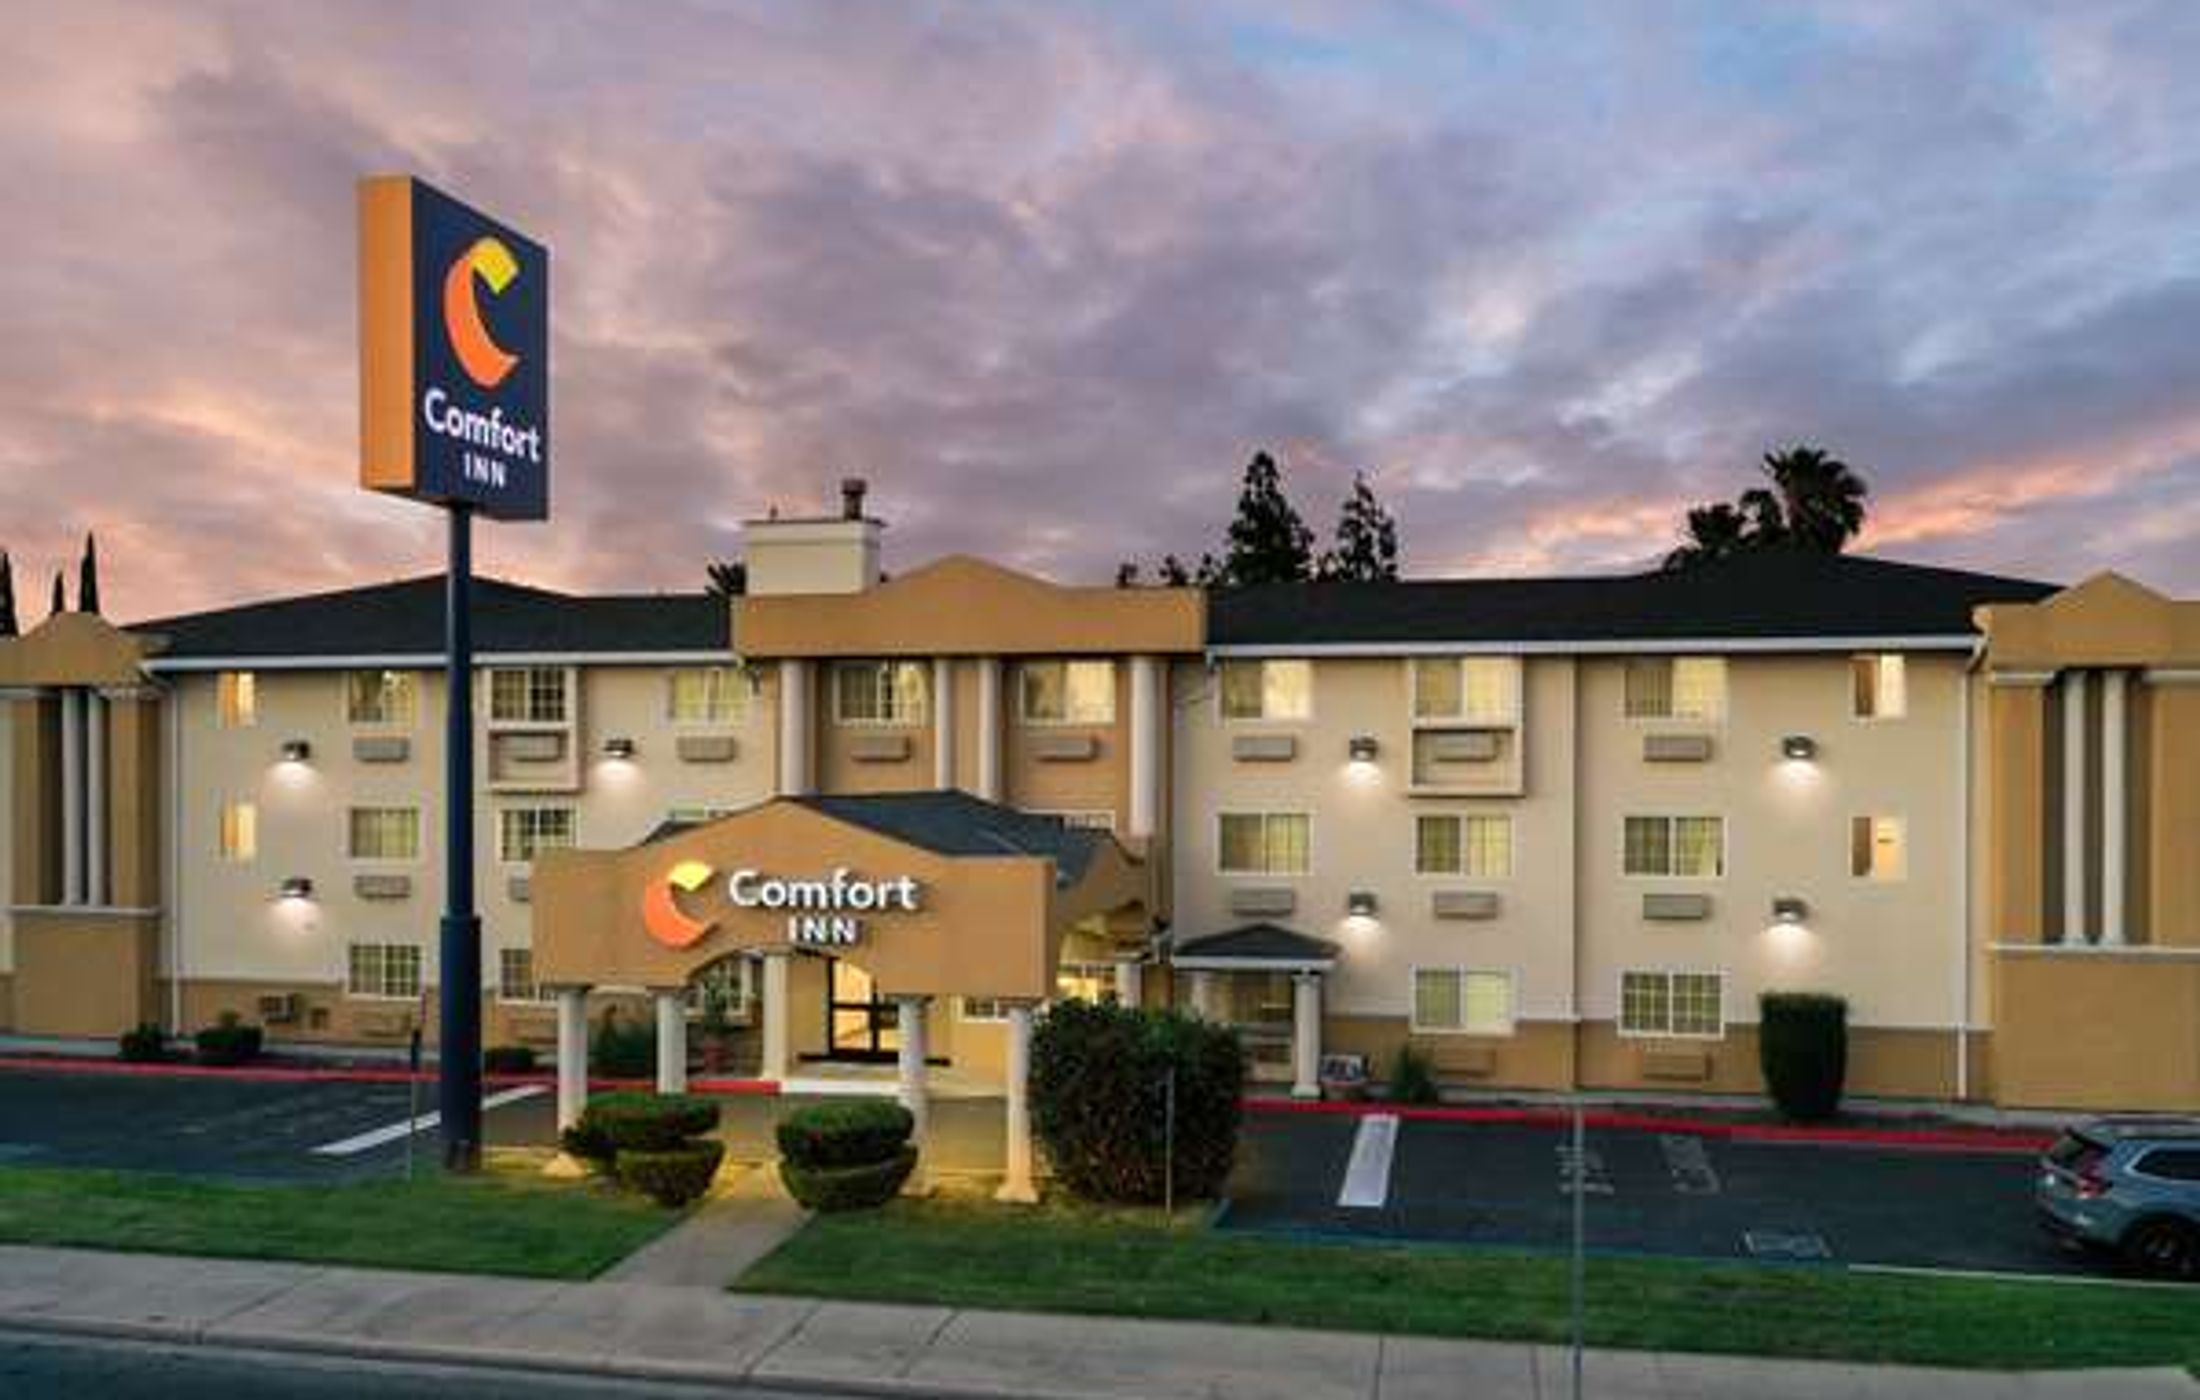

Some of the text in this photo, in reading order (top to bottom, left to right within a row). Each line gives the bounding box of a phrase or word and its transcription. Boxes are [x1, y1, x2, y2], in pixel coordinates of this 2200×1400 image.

[424, 388, 541, 462] Comfort
[464, 453, 506, 487] INN
[729, 867, 917, 910] Comfort
[788, 915, 857, 943] INN
